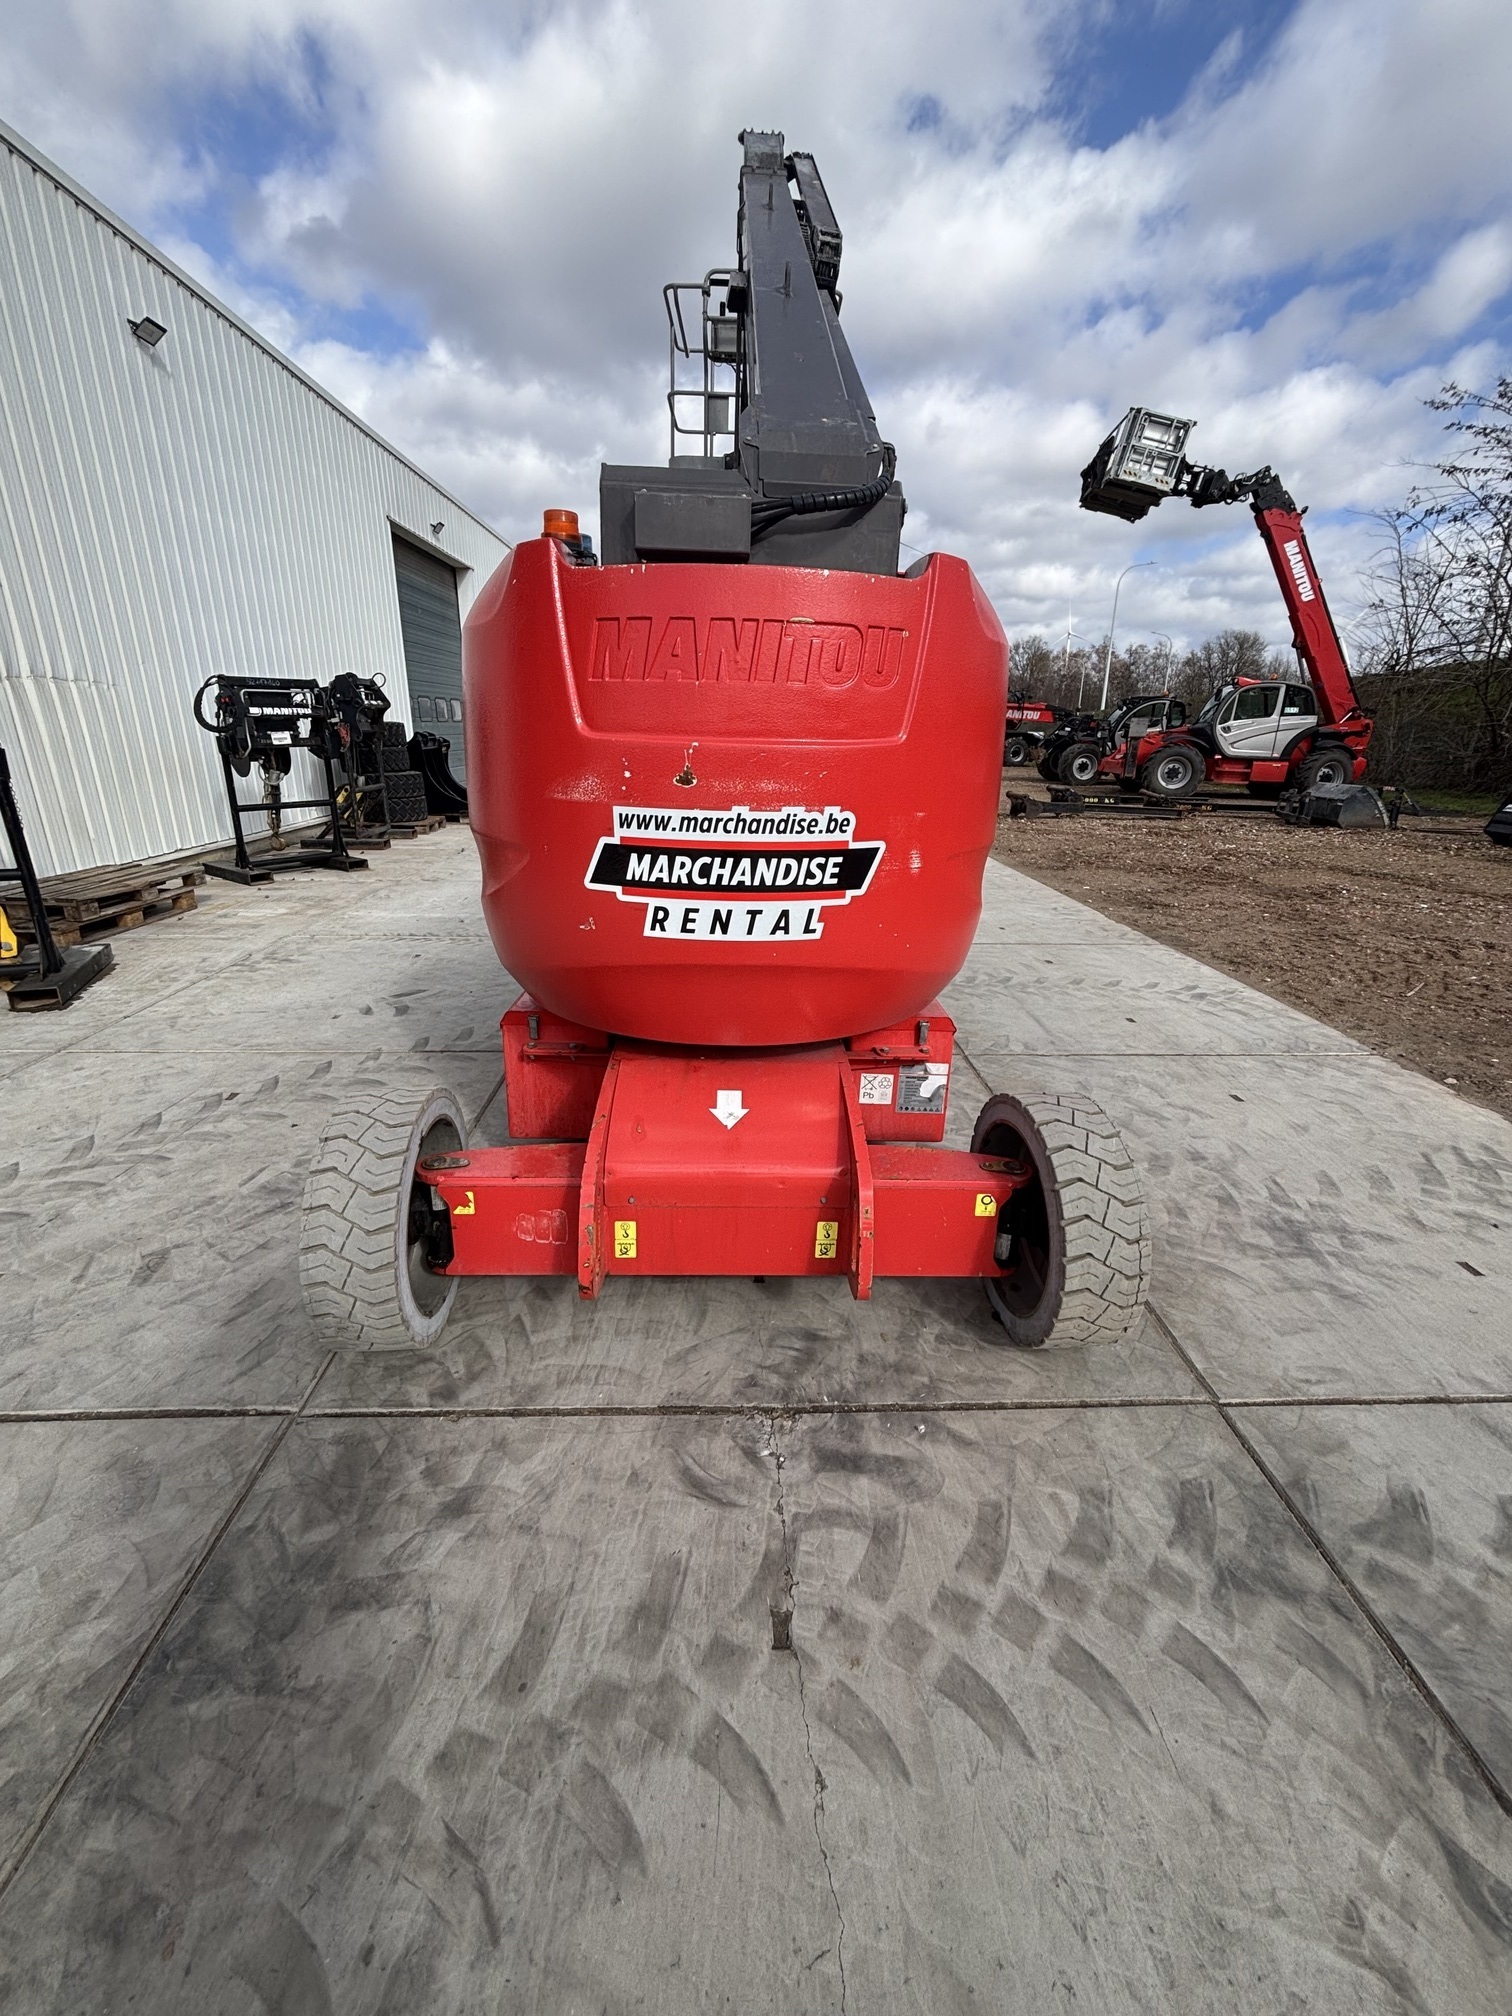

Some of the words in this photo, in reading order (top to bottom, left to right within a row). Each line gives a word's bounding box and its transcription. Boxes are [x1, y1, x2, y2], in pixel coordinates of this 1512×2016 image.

[1283, 539, 1316, 602] MANITOU
[588, 616, 905, 689] MANITOU
[1006, 709, 1041, 720] ANITOU
[618, 812, 850, 835] www.marchandise.be
[625, 853, 844, 886] MARCHANDISE
[649, 905, 818, 936] RENTAL
[862, 1091, 875, 1099] Pb
